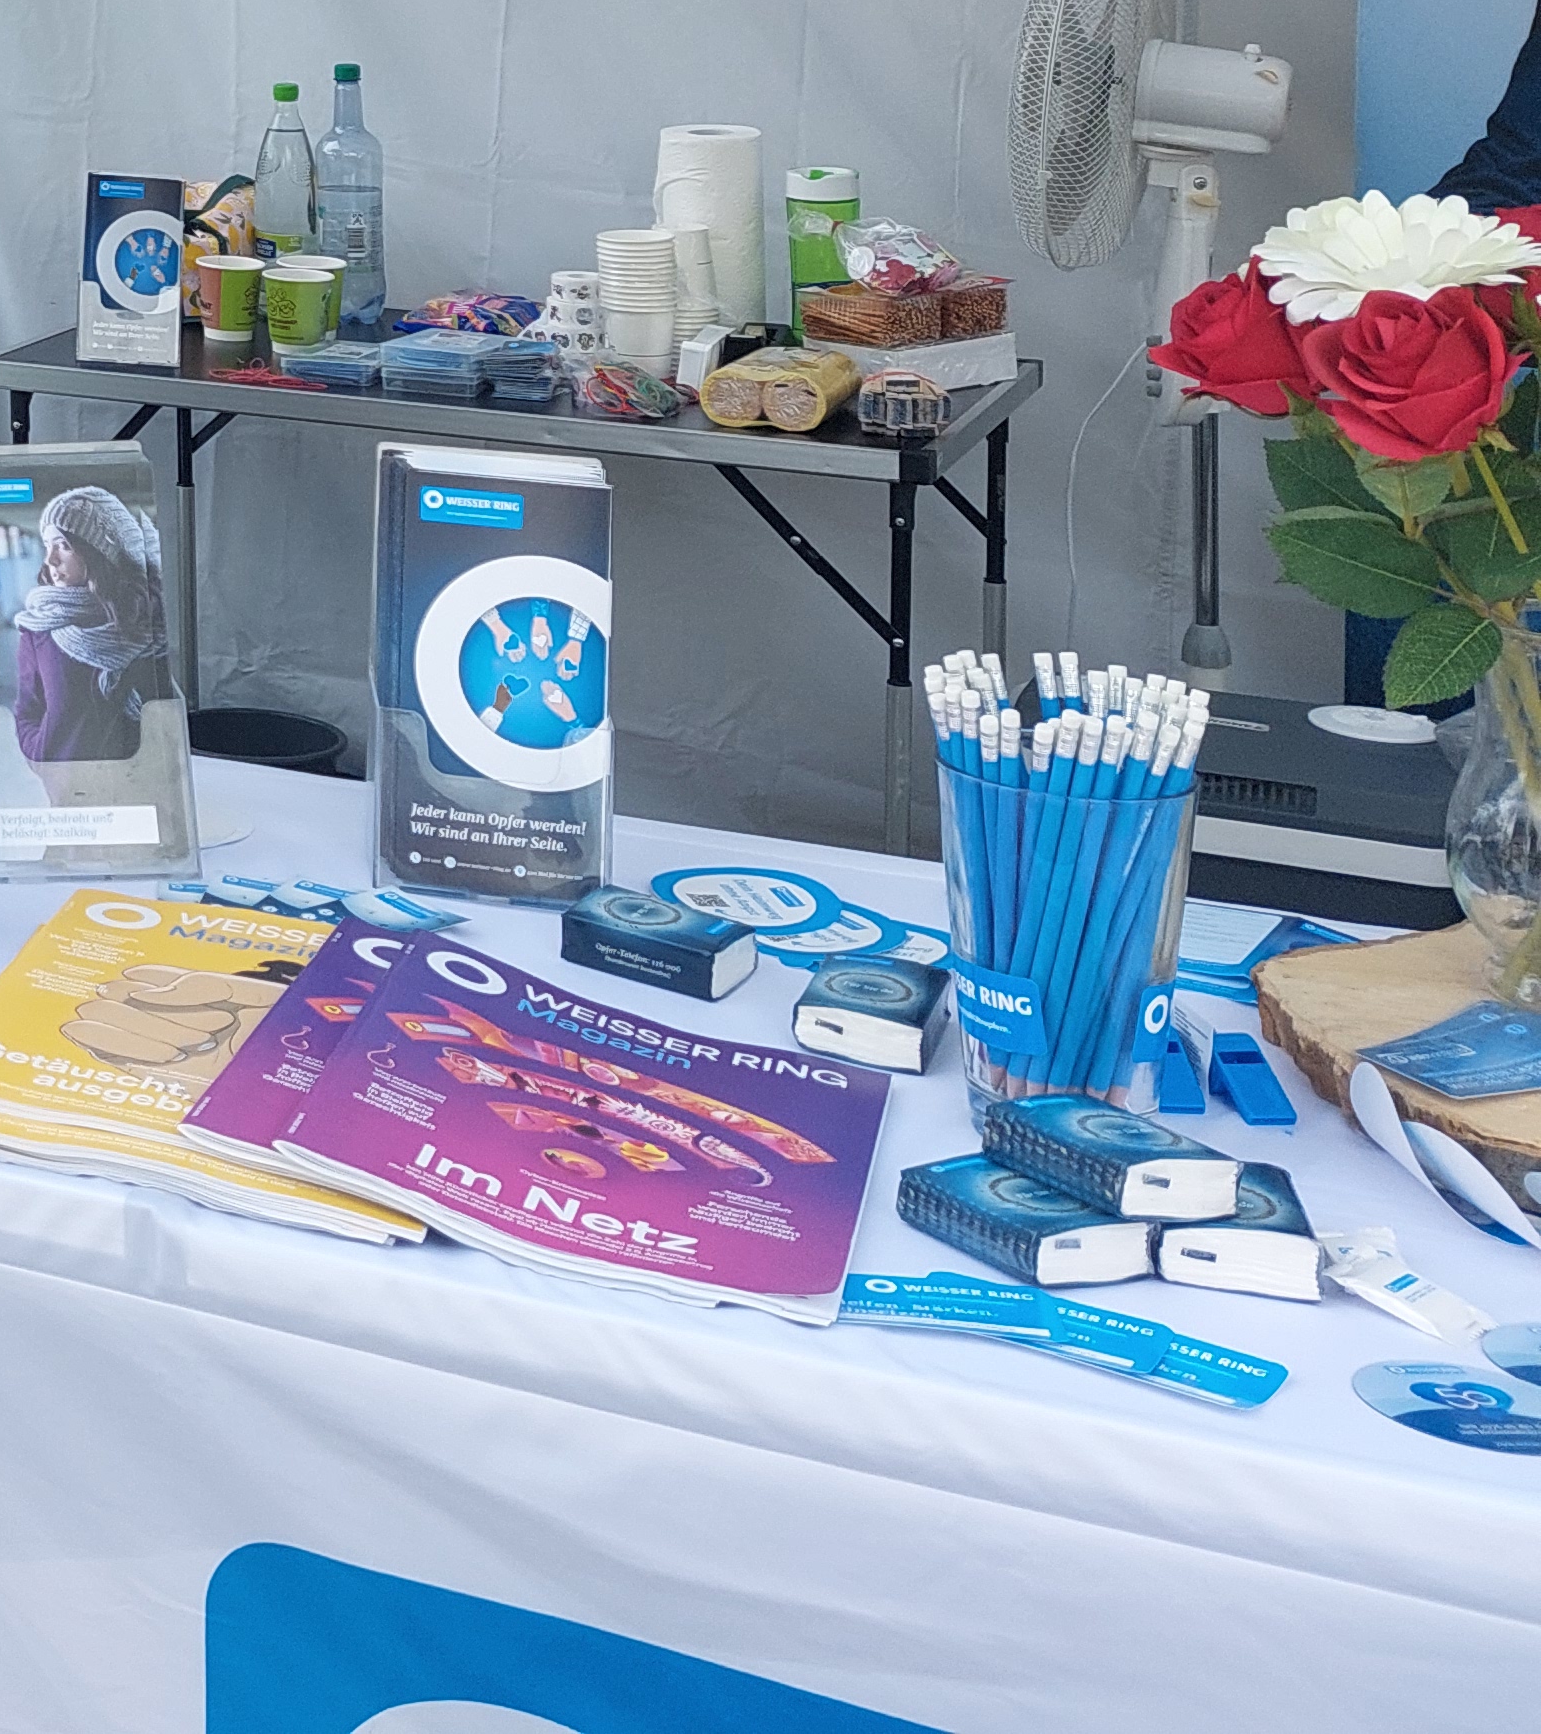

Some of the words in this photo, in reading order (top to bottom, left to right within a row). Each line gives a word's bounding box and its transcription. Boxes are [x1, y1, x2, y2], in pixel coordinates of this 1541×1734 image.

[446, 496, 492, 511] WEISSER
[493, 499, 520, 513] RING
[410, 803, 448, 820] Jeder
[449, 807, 485, 825] kann
[488, 812, 527, 830] Opfer
[529, 818, 588, 837] werden!
[409, 821, 436, 837] Wir
[438, 824, 469, 841] sind
[470, 832, 489, 844] an
[492, 832, 528, 848] Ihrer
[530, 836, 569, 853] Seite.
[979, 985, 1033, 1017] RING
[516, 996, 692, 1070] Magazin
[523, 982, 722, 1063] WEISSER
[732, 1052, 849, 1089] RING
[413, 1143, 504, 1197] Im
[522, 1184, 700, 1256] Netz
[902, 1283, 985, 1299] WEISSER
[988, 1291, 1035, 1302] RING
[1105, 1316, 1155, 1338] RING
[1218, 1356, 1268, 1380] RING
